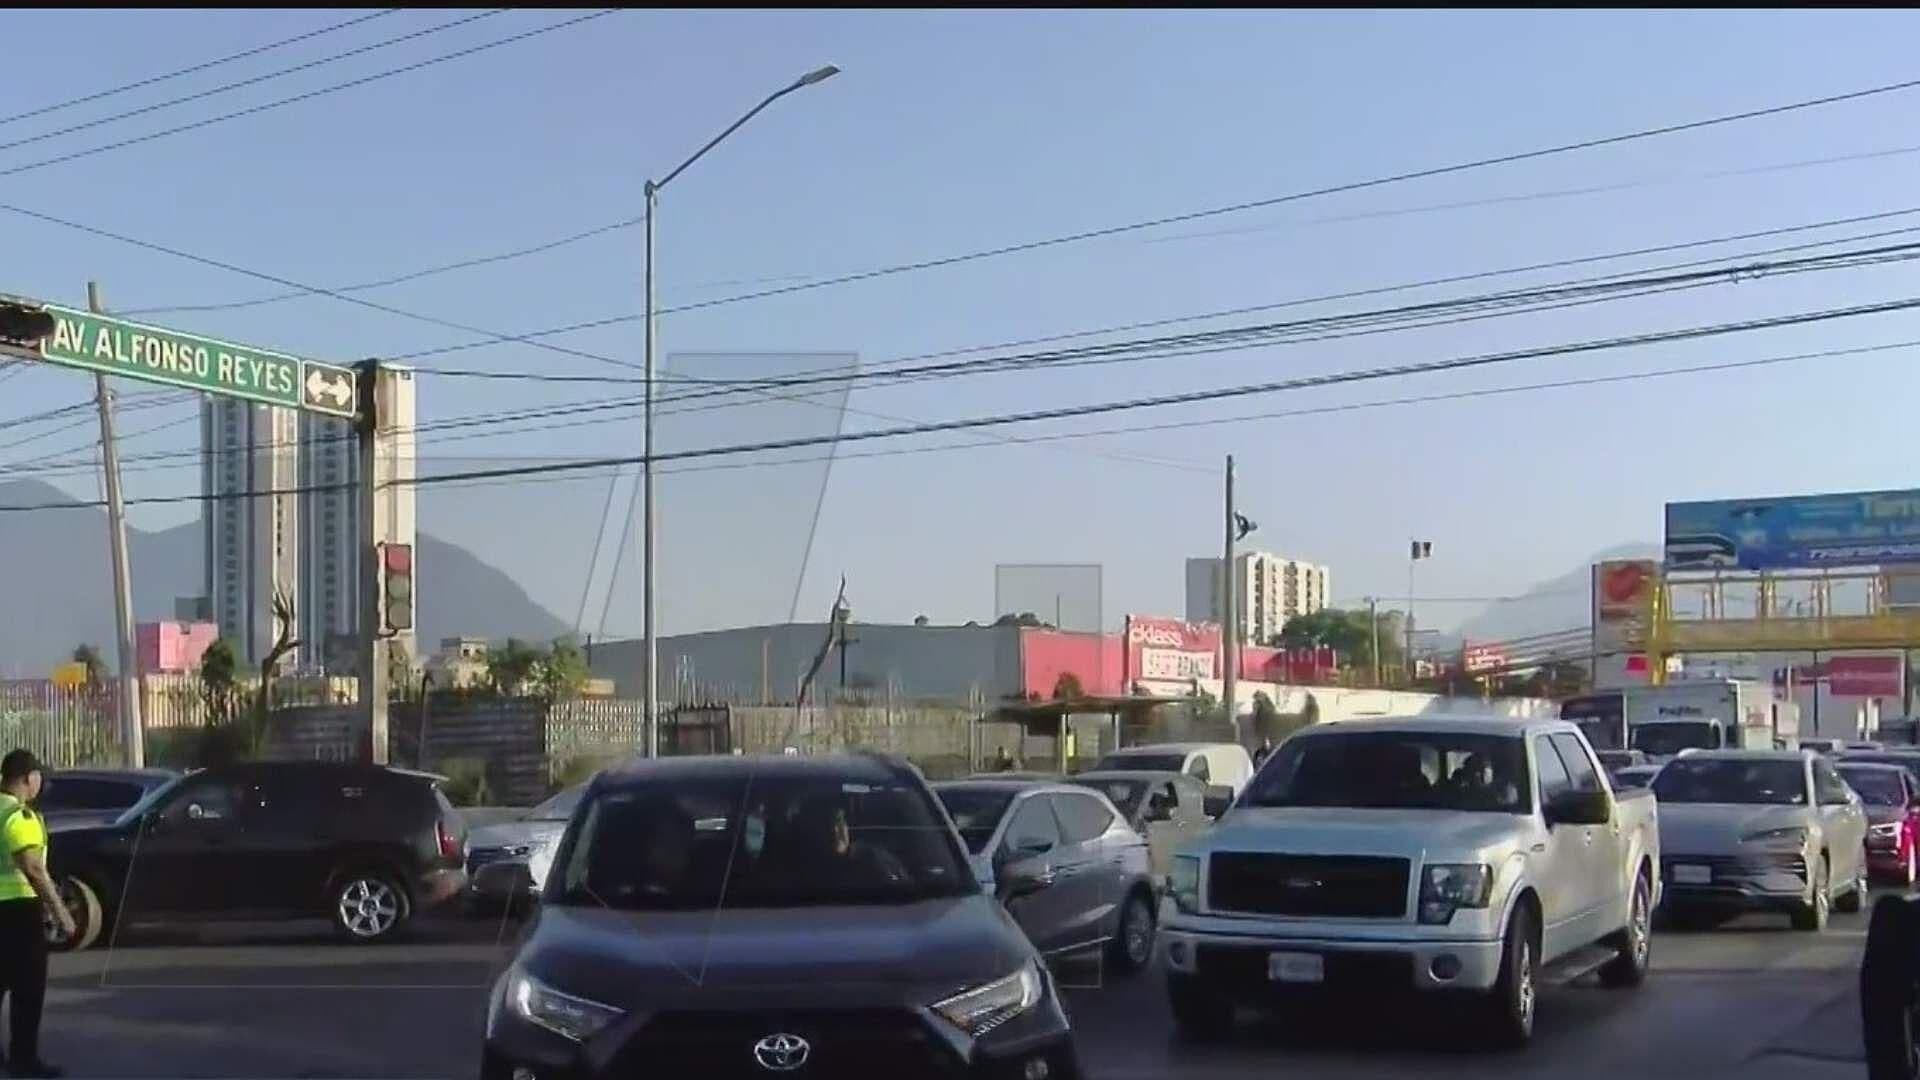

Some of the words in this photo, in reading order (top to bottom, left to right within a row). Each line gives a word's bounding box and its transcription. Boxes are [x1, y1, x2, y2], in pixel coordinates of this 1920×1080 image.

[53, 317, 89, 355] AV.
[94, 327, 209, 379] ALFONSO
[217, 352, 294, 394] REYES
